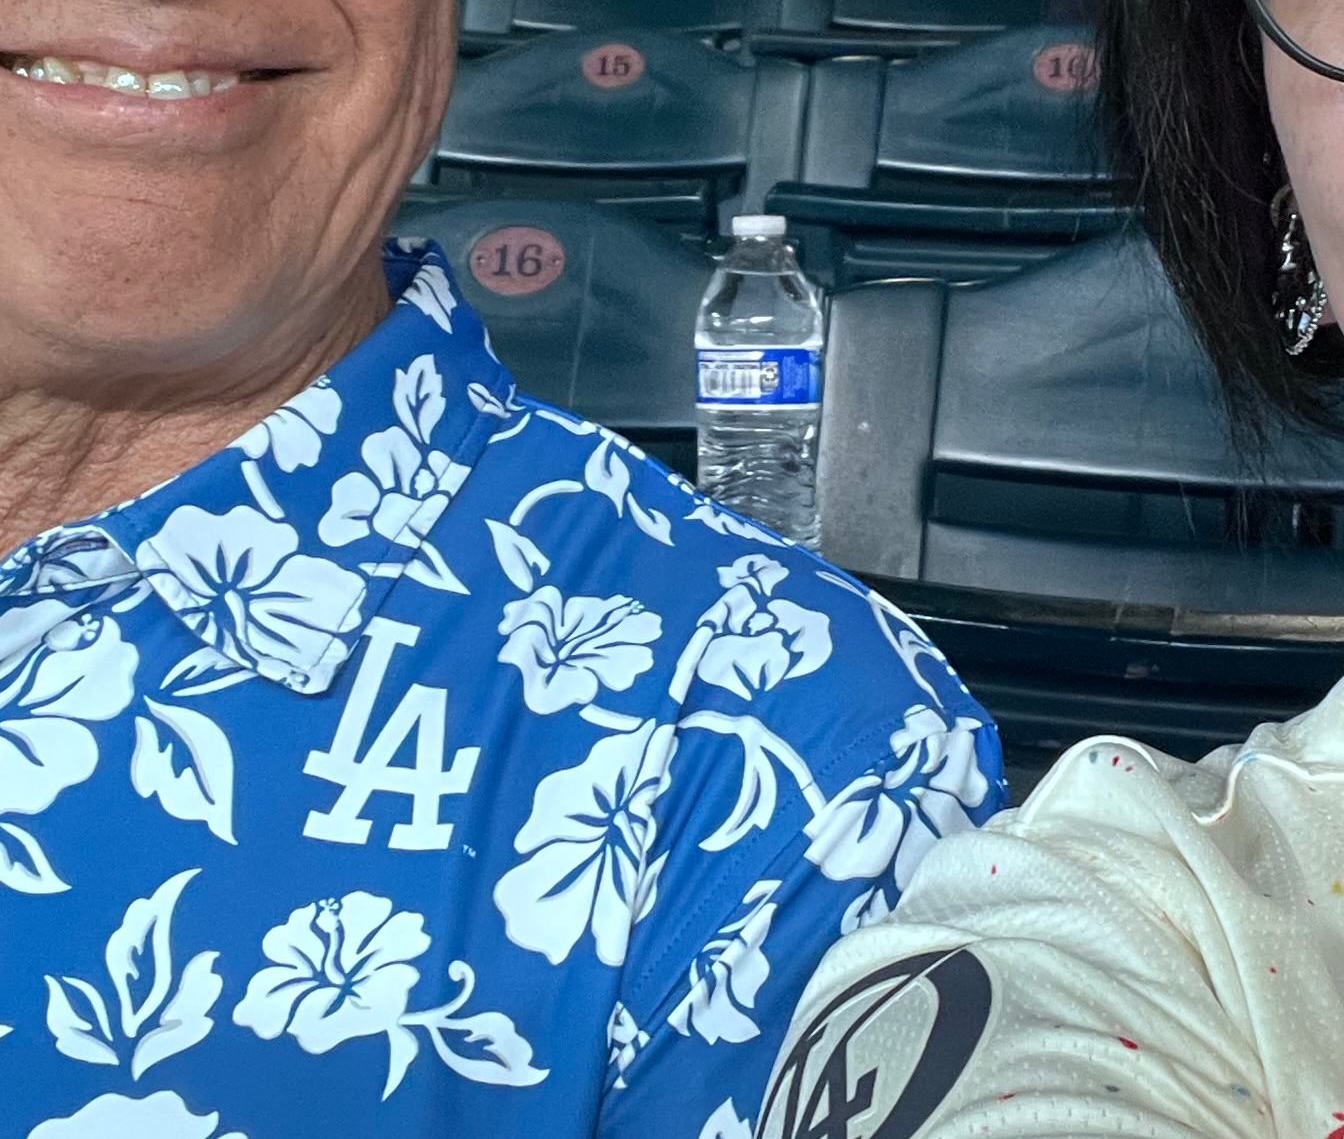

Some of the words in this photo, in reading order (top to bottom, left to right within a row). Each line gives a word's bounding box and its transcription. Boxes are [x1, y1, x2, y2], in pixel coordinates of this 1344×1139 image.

[597, 55, 631, 77] 15
[492, 244, 543, 277] 16
[303, 616, 481, 850] LA
